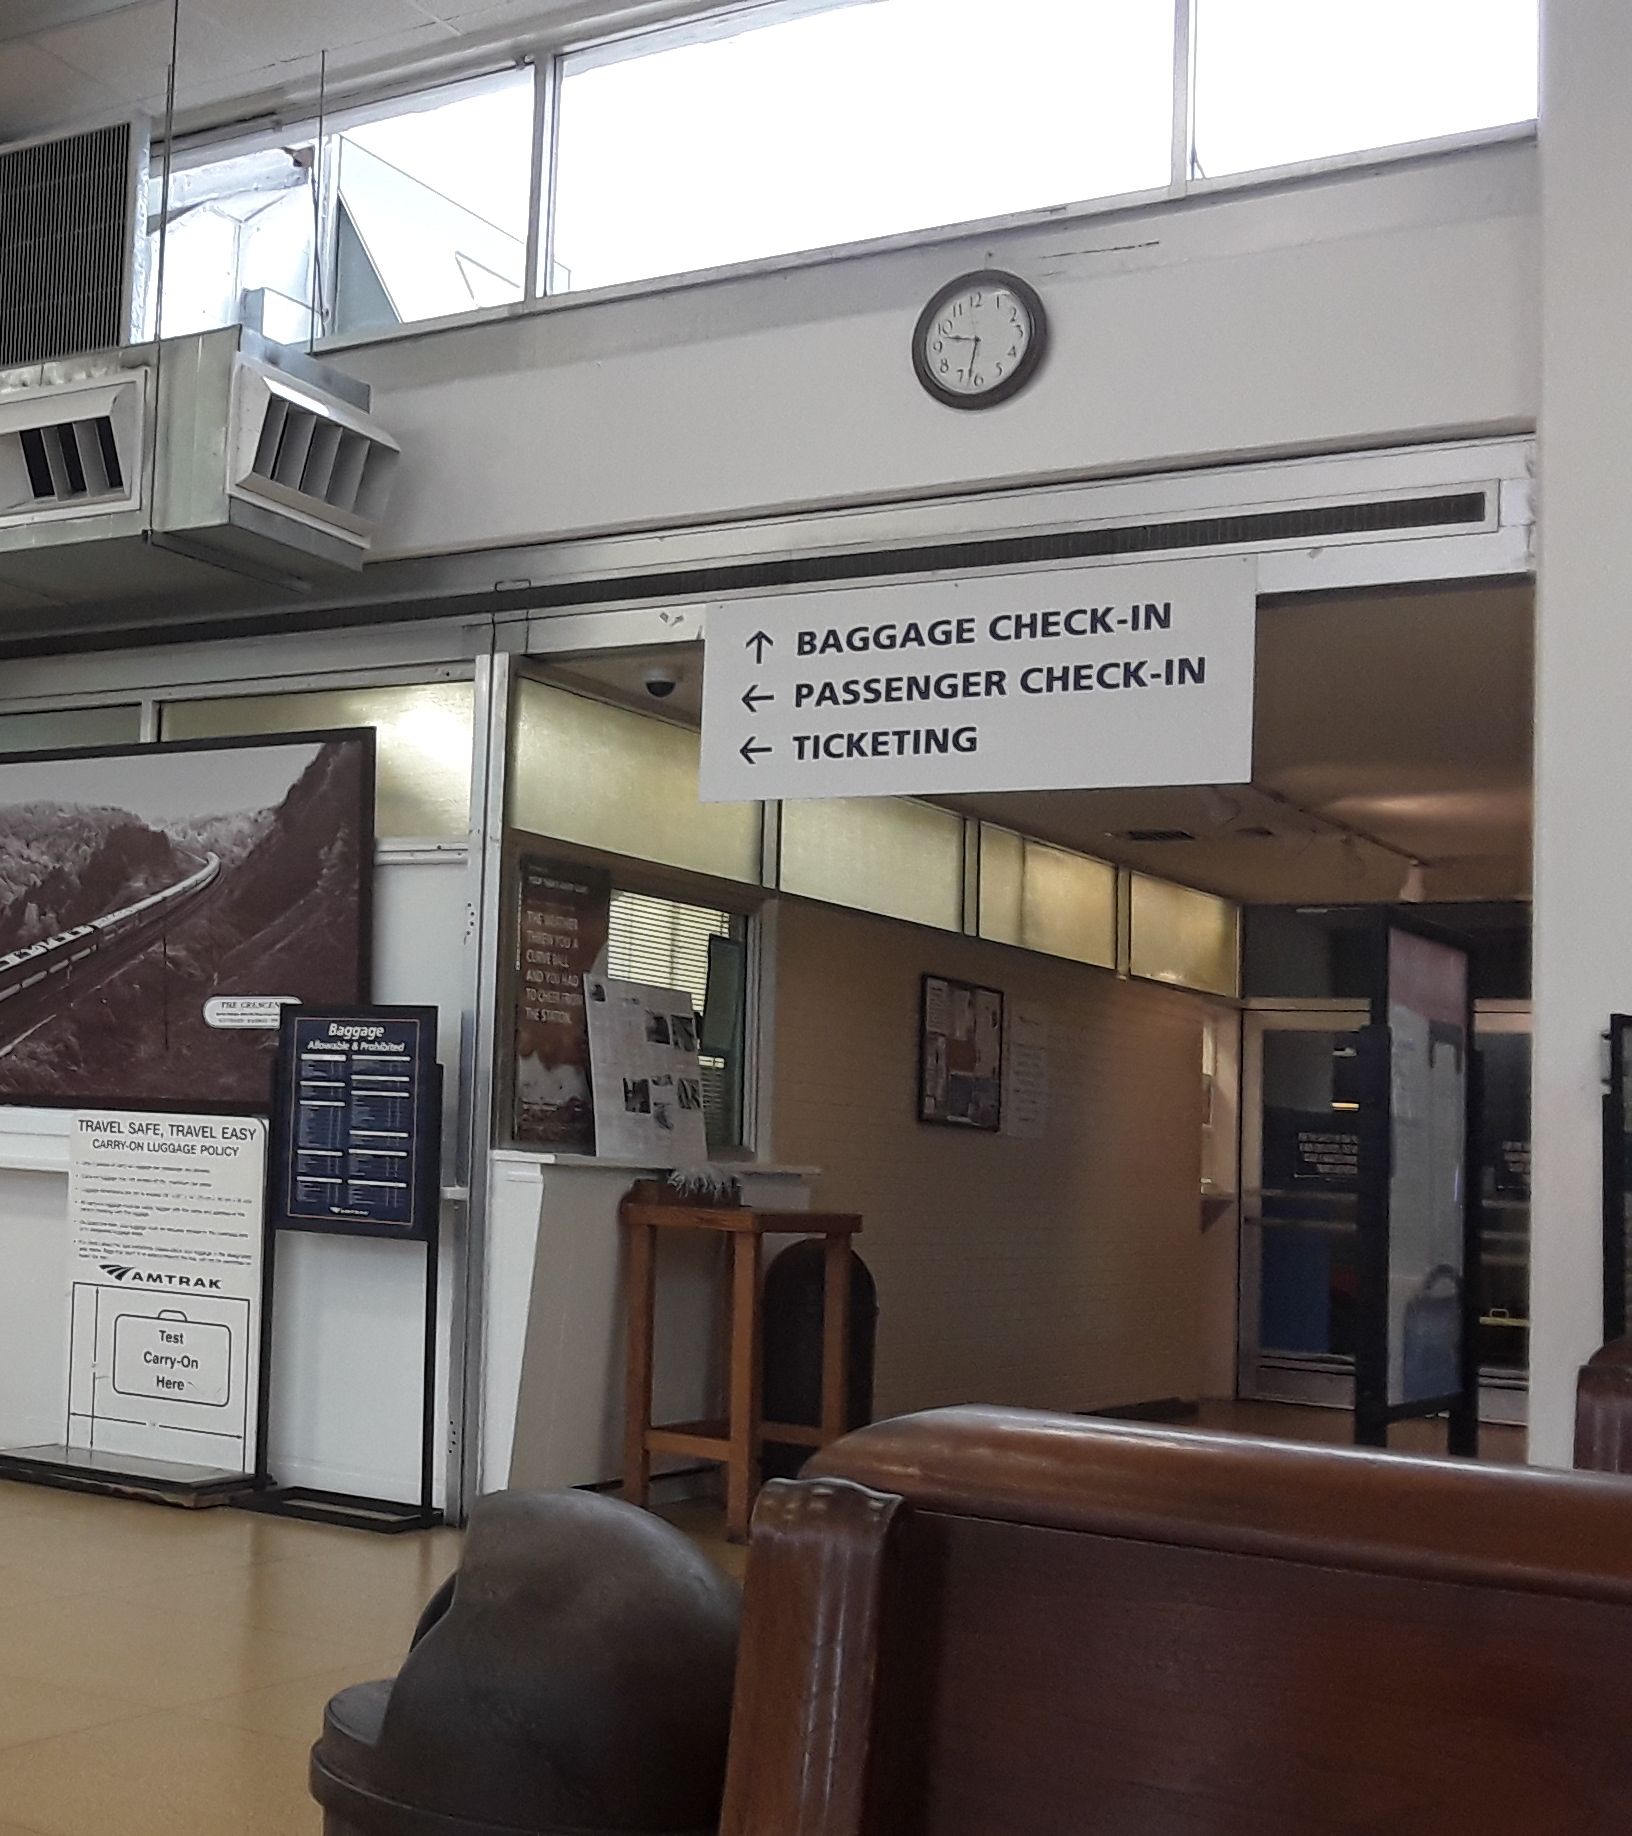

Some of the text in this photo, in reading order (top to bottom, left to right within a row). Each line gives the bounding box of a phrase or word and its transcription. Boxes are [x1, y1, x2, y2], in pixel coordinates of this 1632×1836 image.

[969, 291, 982, 308] 12
[952, 303, 963, 318] 11
[1009, 306, 1017, 322] 2
[937, 319, 953, 335] 10
[1015, 324, 1024, 338] 3
[932, 340, 943, 354] 9
[1007, 345, 1017, 358] 4
[939, 359, 949, 374] 8
[995, 361, 1003, 377] 5
[956, 368, 964, 383] 7
[973, 374, 984, 387] 6
[797, 602, 1172, 656] BAGGAGE CHECK-IN
[794, 656, 1206, 708] PASSENGER CHECK-IN
[793, 726, 978, 760] TICKETING
[526, 969, 544, 983] AND
[546, 972, 561, 984] YOU
[526, 987, 537, 1001] TO
[525, 1006, 540, 1020] THE
[328, 1022, 385, 1039] Baggage
[307, 1040, 405, 1052] Allowable & Prohibited
[78, 1119, 256, 1141] TRAVEL SAFE, TRAVEL EASY
[92, 1138, 239, 1157] CARRY-ON LUGGAGE POLICY
[132, 1272, 222, 1289] AMTRAK
[159, 1330, 184, 1344] Test
[143, 1351, 199, 1369] Carry-On
[156, 1376, 185, 1390] Here
